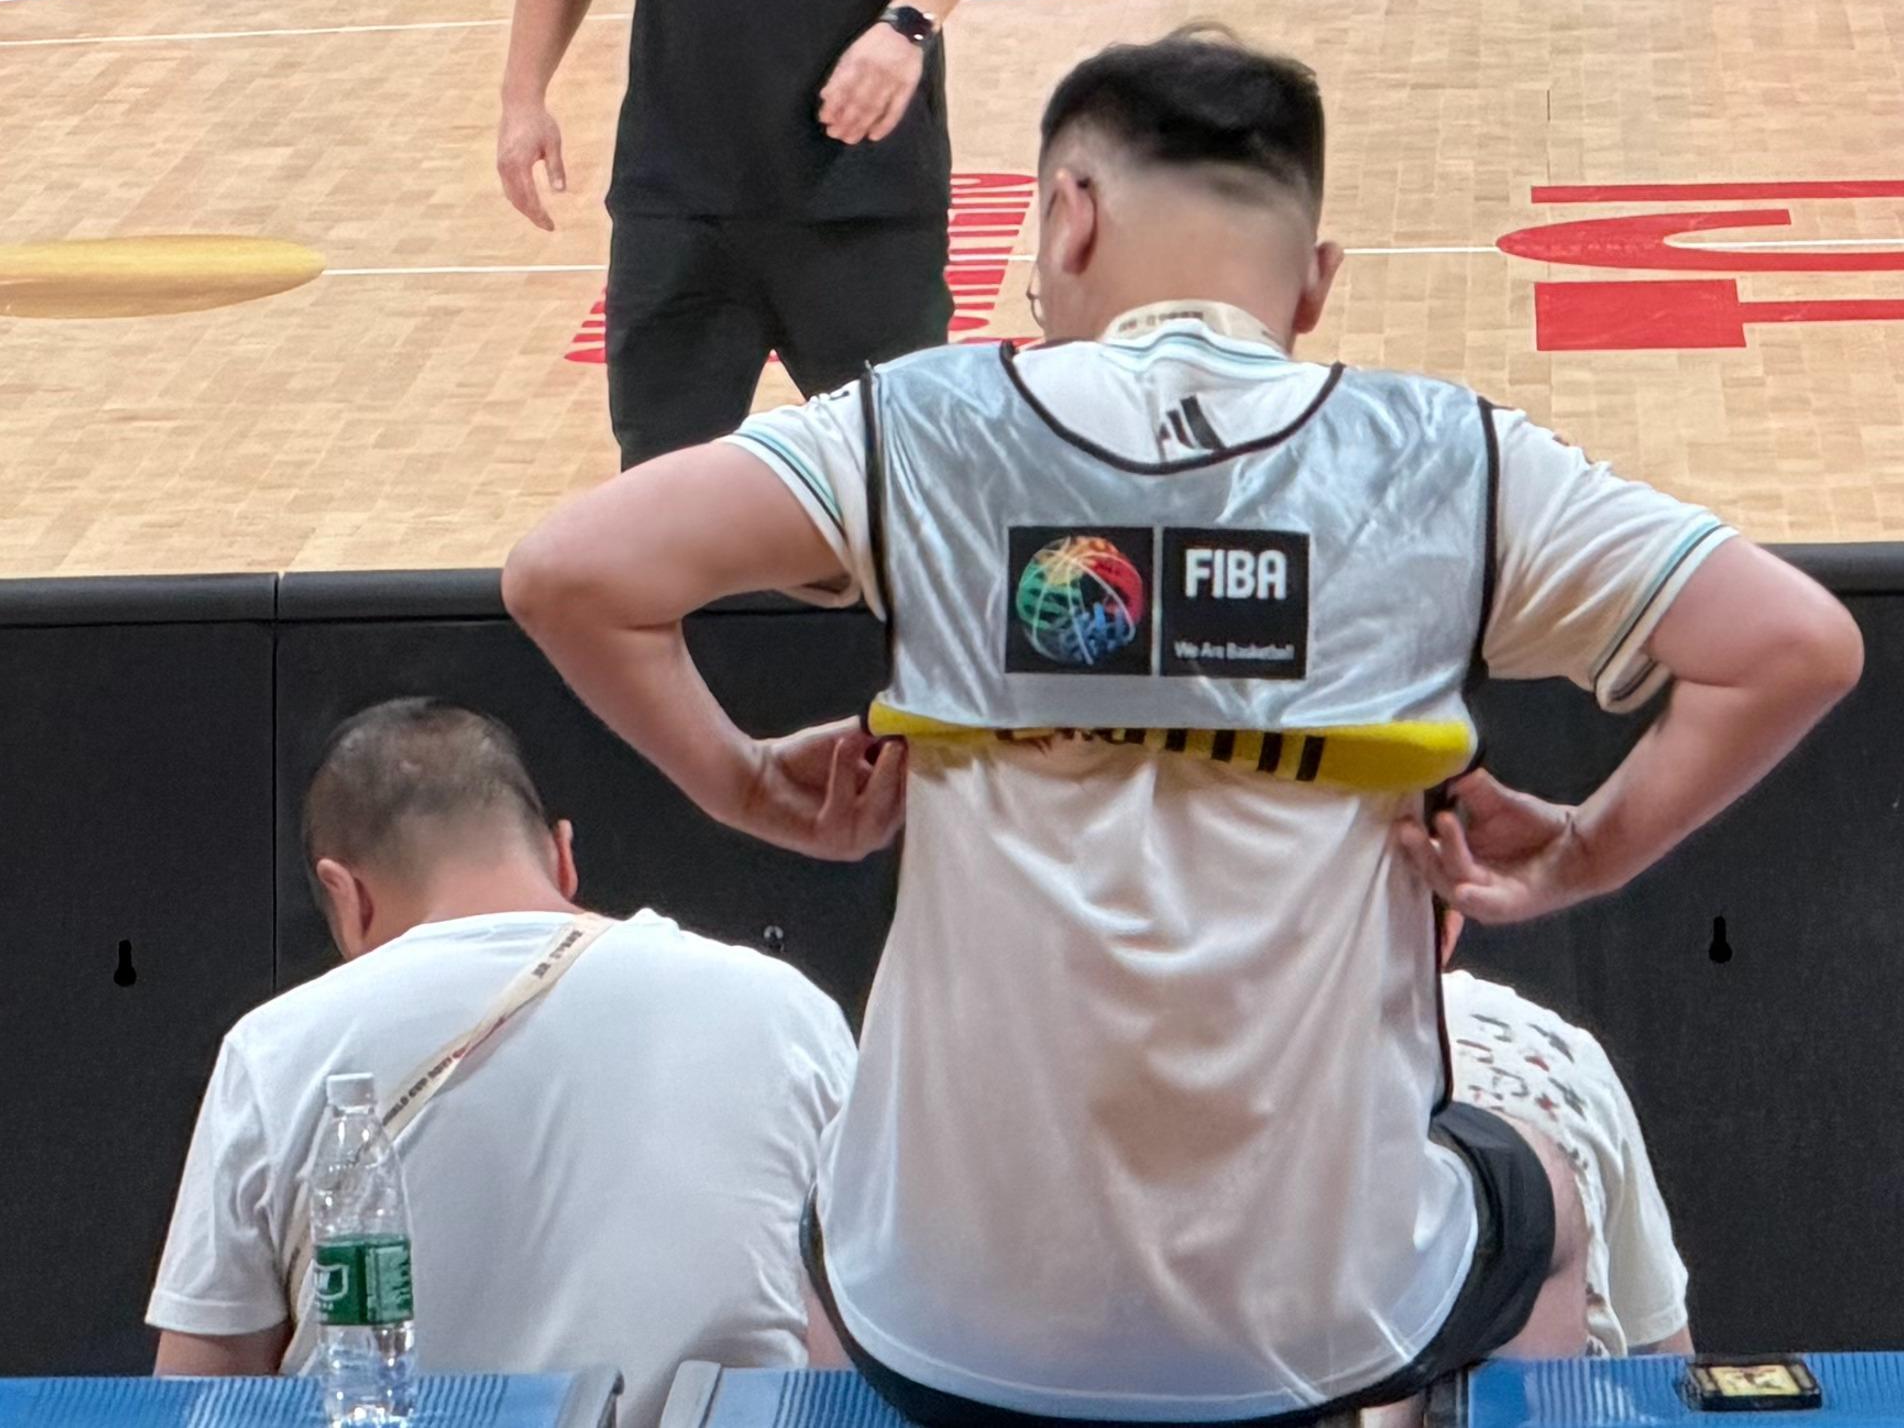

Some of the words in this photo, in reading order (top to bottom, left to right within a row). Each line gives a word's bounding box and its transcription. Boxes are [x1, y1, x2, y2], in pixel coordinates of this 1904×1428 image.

[1184, 549, 1288, 601] FIBA
[1174, 640, 1198, 660] We
[1201, 641, 1225, 660] Are
[1227, 642, 1295, 662] Basketball
